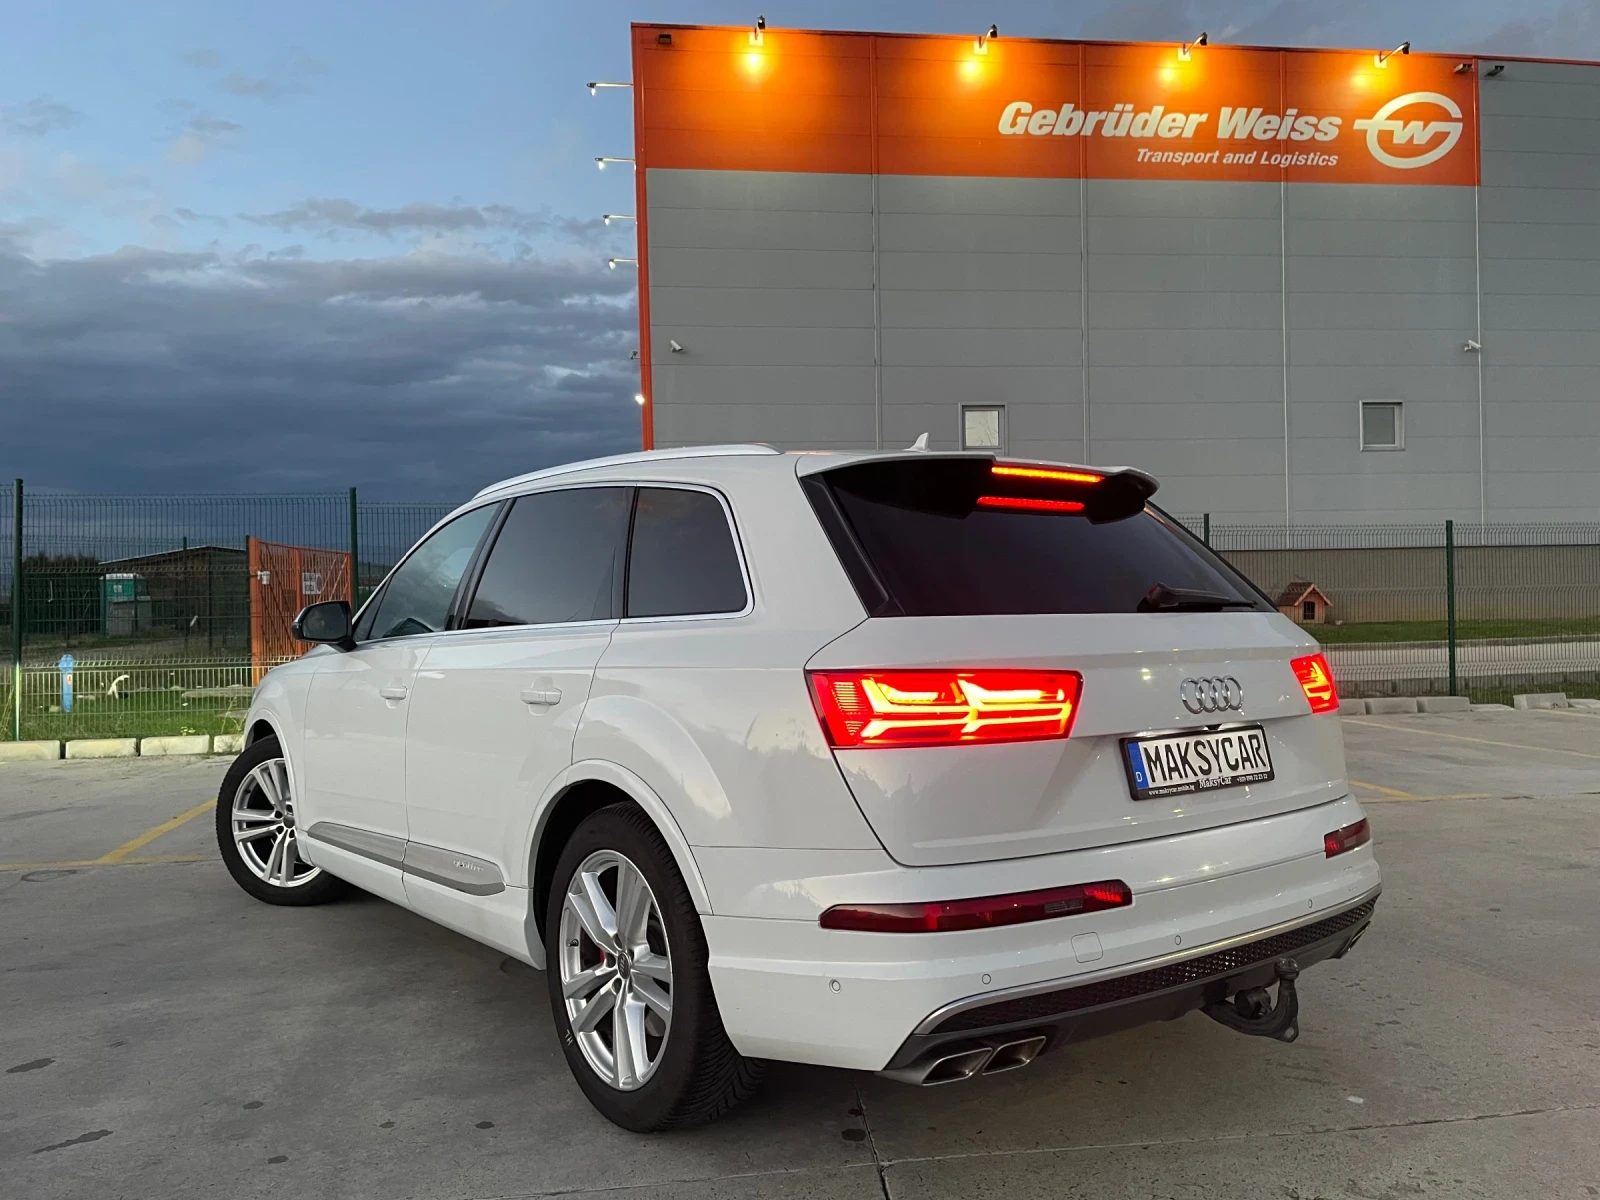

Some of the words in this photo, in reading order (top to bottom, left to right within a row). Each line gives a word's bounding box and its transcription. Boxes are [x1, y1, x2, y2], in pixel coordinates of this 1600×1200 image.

[998, 101, 1208, 138] Gebrüder
[1217, 106, 1342, 141] Weiss
[1137, 148, 1220, 165] Transport
[1222, 151, 1257, 165] and
[1260, 151, 1339, 168] Logistics
[1143, 734, 1267, 783] MAKSYCAR
[1136, 771, 1143, 782] D
[1198, 776, 1232, 788] MaksyCar
